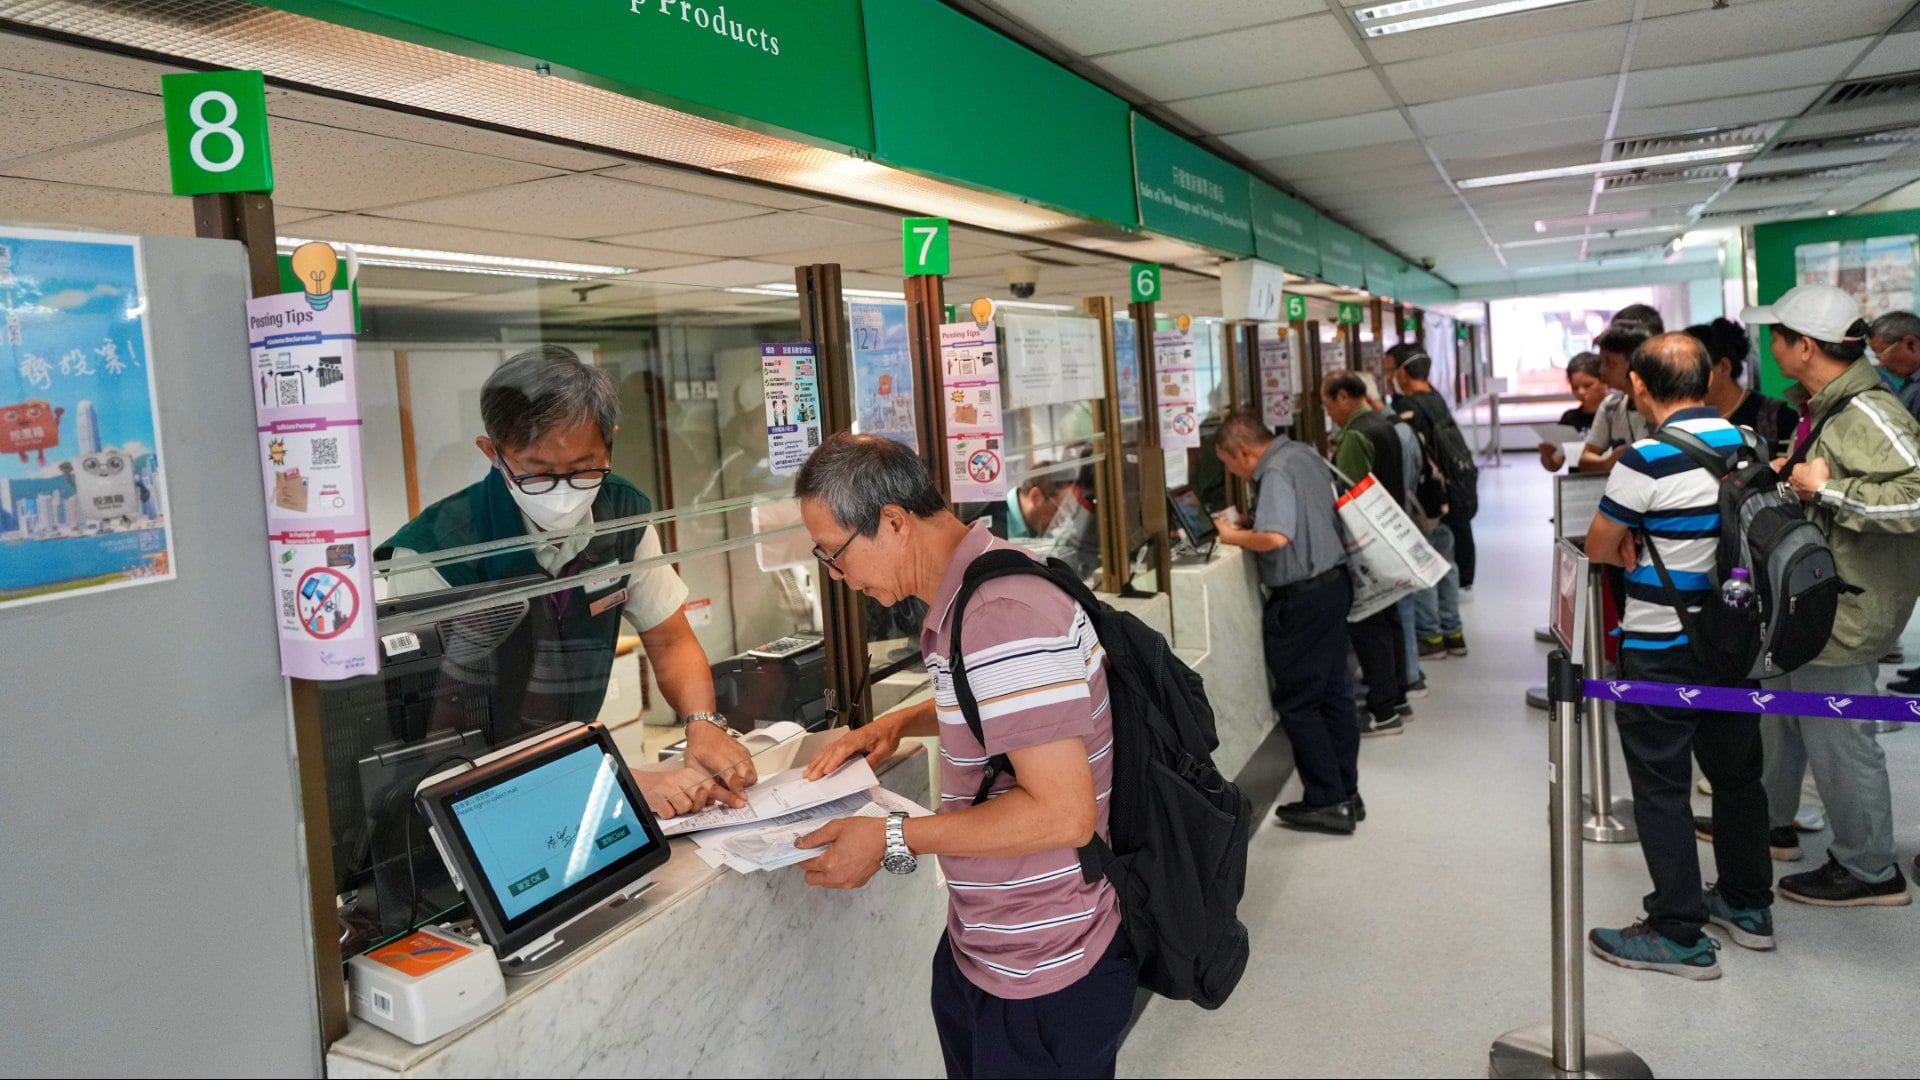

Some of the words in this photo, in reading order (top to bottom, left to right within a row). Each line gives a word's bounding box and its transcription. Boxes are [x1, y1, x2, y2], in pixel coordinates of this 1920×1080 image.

[189, 90, 245, 173] 8
[912, 226, 939, 266] 7
[1137, 269, 1155, 296] 6
[1289, 298, 1302, 316] 5
[1340, 305, 1352, 320] 4
[250, 312, 283, 329] Posting
[285, 309, 314, 326] Tips
[942, 331, 966, 339] Posting
[966, 330, 981, 338] Tips
[530, 872, 542, 884] OK
